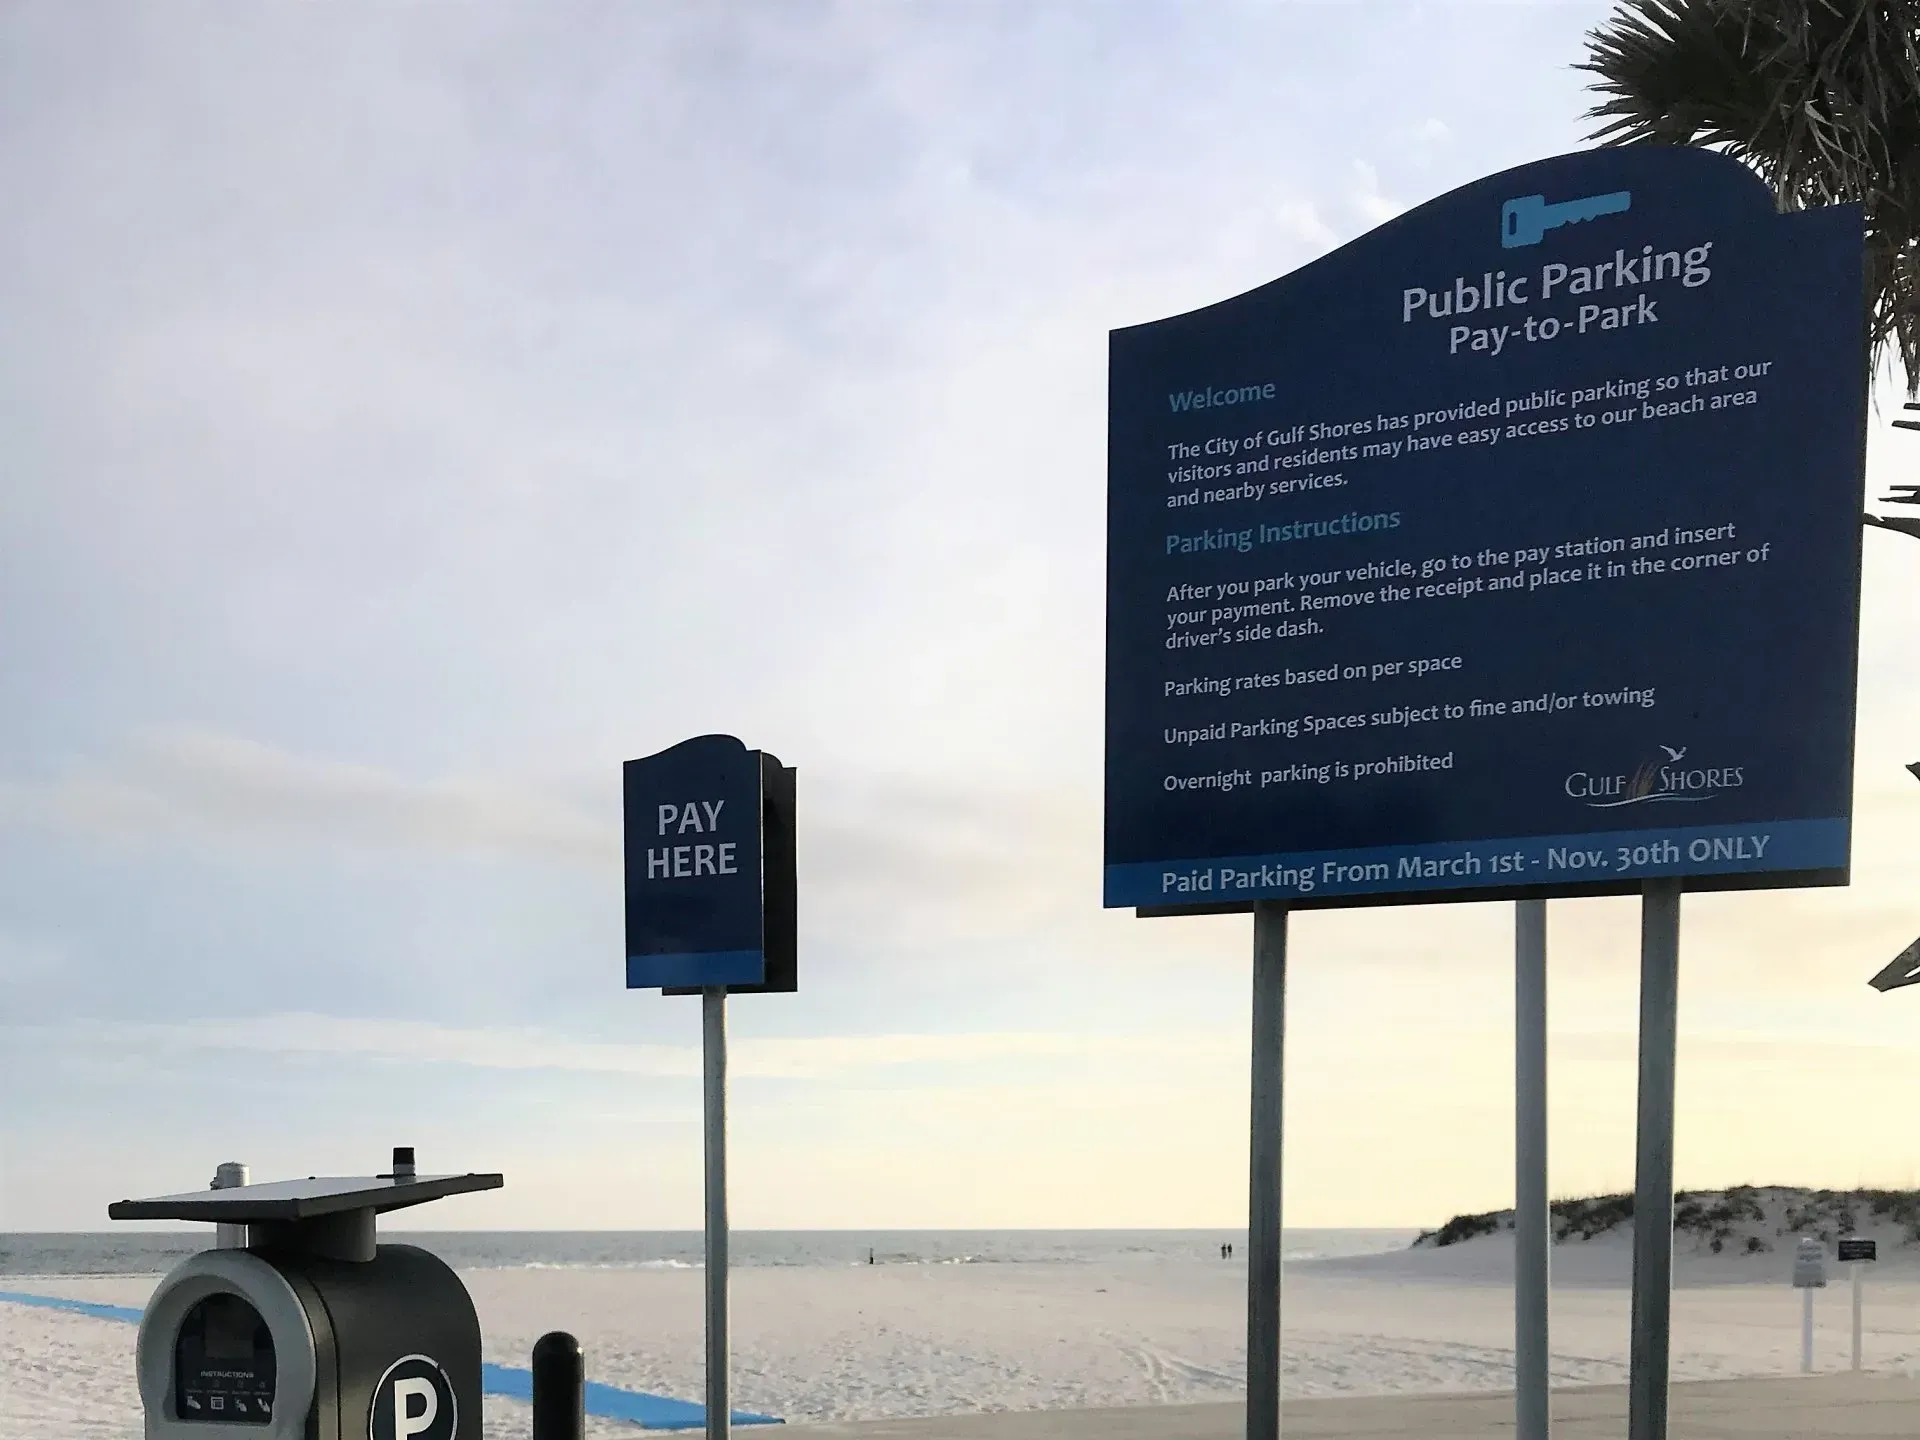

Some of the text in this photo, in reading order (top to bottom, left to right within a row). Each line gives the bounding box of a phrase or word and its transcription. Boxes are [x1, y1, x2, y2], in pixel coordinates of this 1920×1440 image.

[1403, 241, 1713, 323] Public Parking
[1449, 293, 1659, 357] Pay-to-Park
[1167, 361, 1773, 461] The City of Gulf Shores has provided public parking so that our
[1168, 383, 1276, 413] Welcome
[1167, 390, 1757, 484] visitors and residents may have easy access to our beach area
[1166, 472, 1349, 508] and nearby services.
[1166, 511, 1401, 555] Parking Instructions
[1166, 522, 1736, 603] After you park your vehicle, go to the pay station and insert
[1166, 542, 1772, 631] your payment. Remove the receipt and place it in the corner of
[1235, 623, 1272, 643] side
[1275, 617, 1324, 638] dash.
[1164, 656, 1463, 697] Parking rates based on per space
[1164, 686, 1656, 747] Unpaid Parking Spaces subject to fine and/or towing
[1163, 751, 1454, 792] Overnight parking is prohibited
[1564, 765, 1744, 798] GULF SHORES
[657, 799, 725, 836] PAY
[647, 842, 738, 879] HERE
[1162, 868, 1213, 894] Paid
[1219, 863, 1316, 892] Parking
[1322, 861, 1389, 884] From
[1396, 851, 1481, 879] March
[1488, 851, 1525, 874] 1st
[1547, 847, 1609, 870] Nov.
[1615, 839, 1680, 872] 30th
[1688, 834, 1770, 862] ONLY
[200, 1370, 254, 1379] INSTRUCTIONS
[394, 1376, 438, 1440] P
